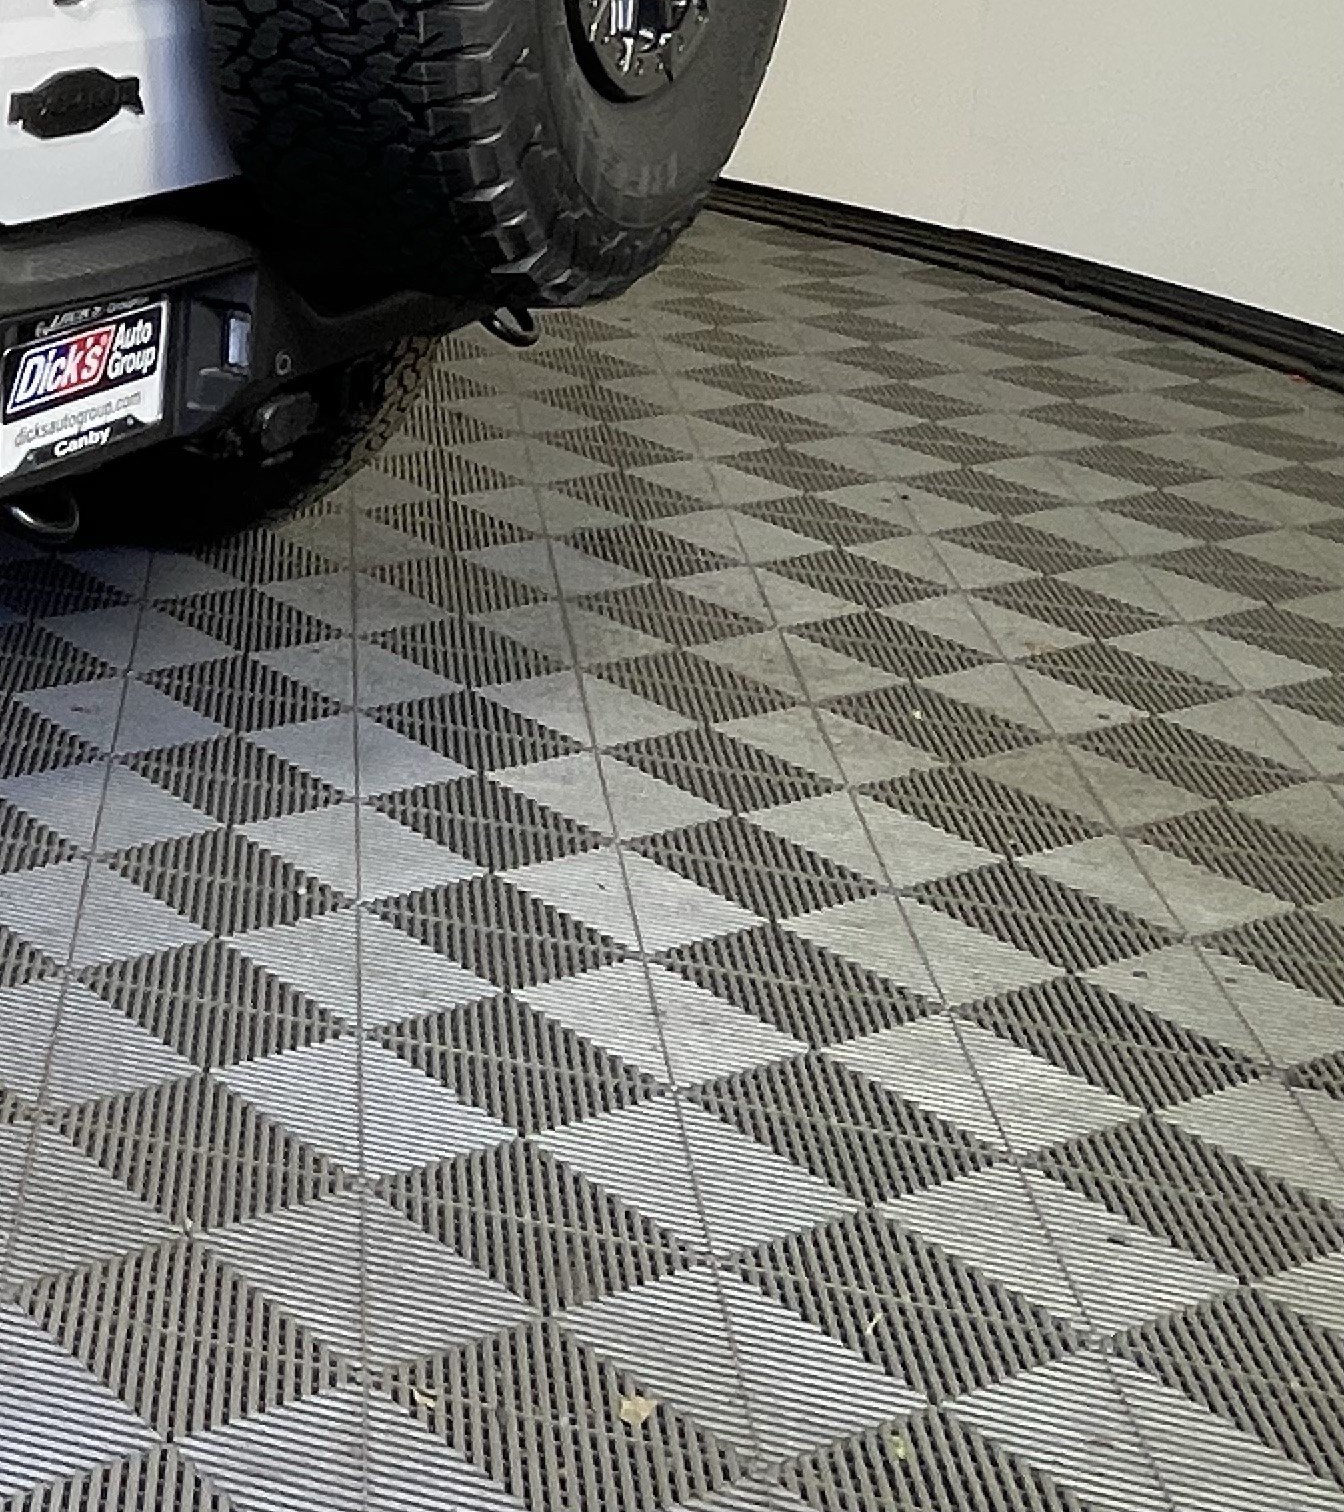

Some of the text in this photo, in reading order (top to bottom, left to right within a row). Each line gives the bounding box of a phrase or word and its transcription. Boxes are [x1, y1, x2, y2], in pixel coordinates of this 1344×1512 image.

[114, 318, 153, 349] Auto
[107, 346, 156, 380] Group
[14, 390, 142, 448] dicksautogroup.com
[54, 427, 111, 458] Canby
